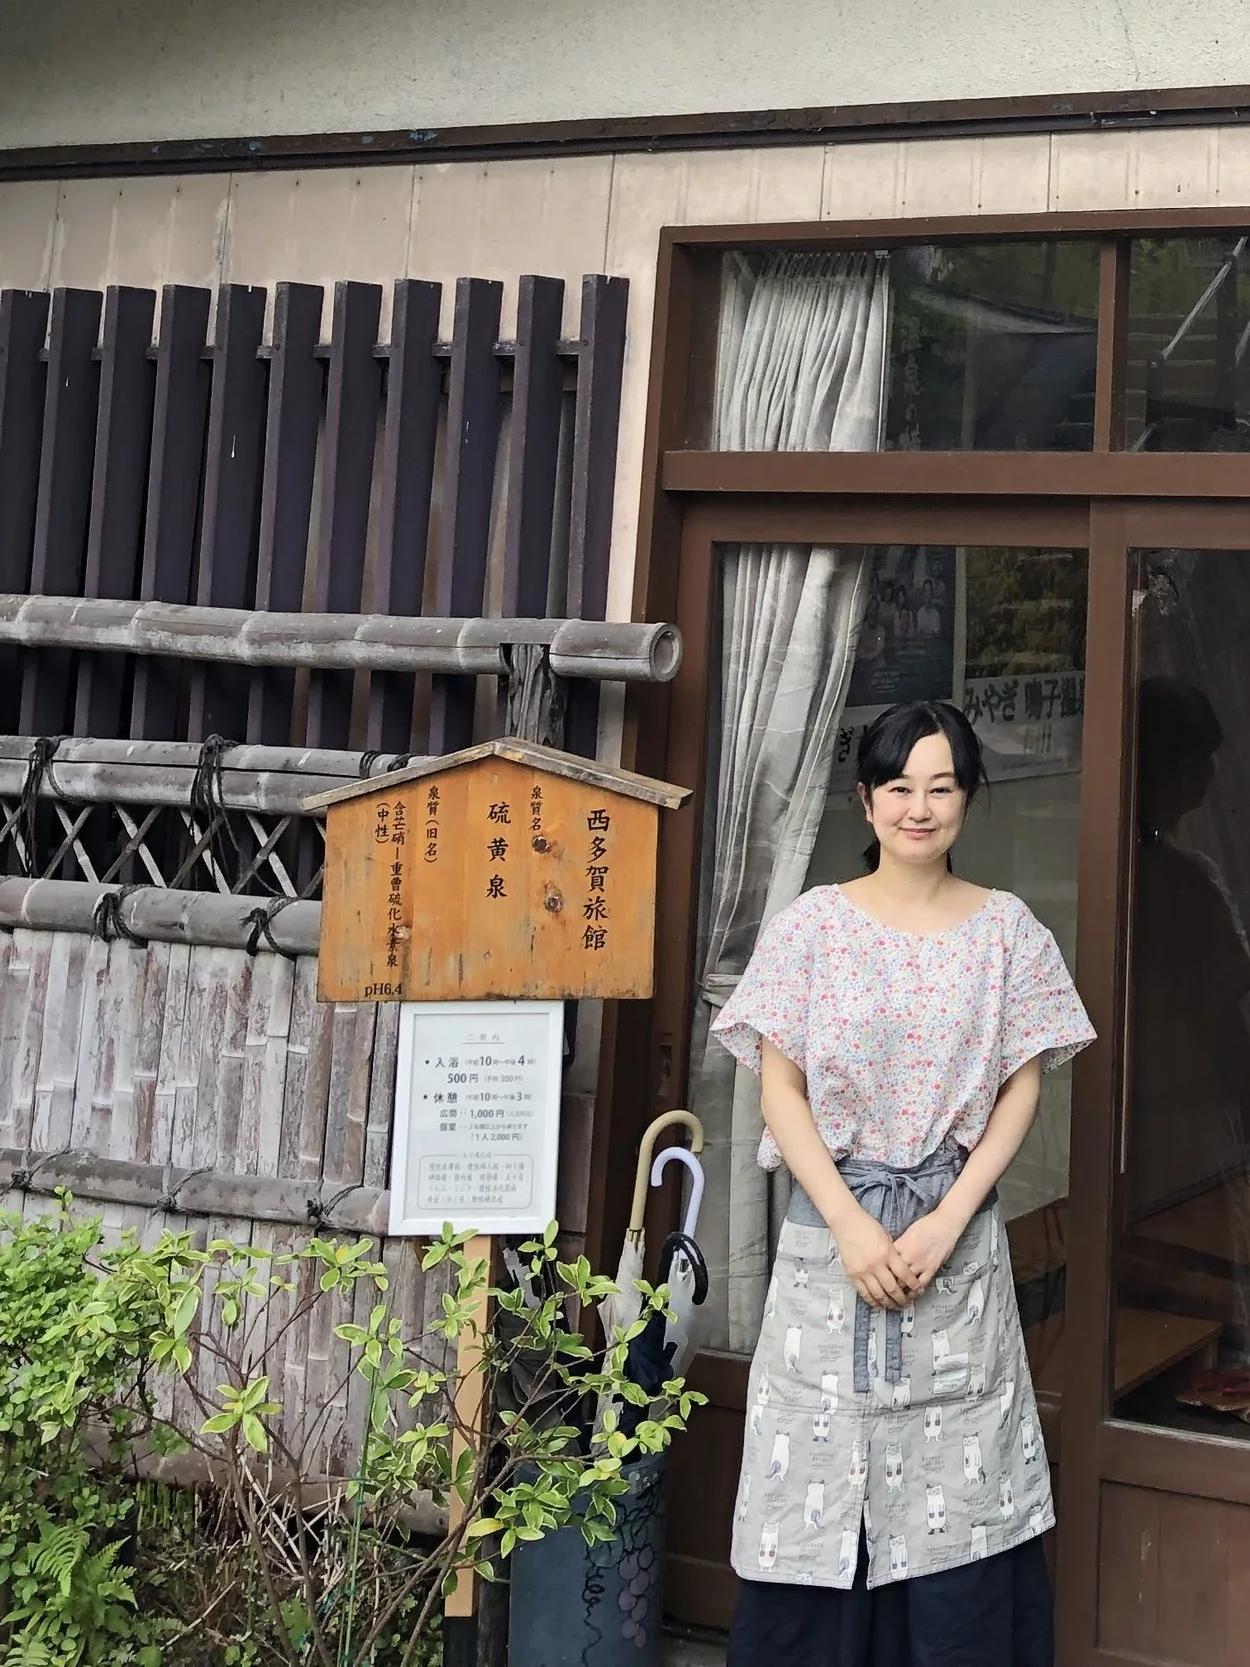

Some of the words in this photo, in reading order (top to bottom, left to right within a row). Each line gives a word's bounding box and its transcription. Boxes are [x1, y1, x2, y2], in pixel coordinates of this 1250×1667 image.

[529, 786, 544, 832] 泉質名
[485, 802, 512, 900] 硫黄泉
[582, 809, 611, 951] 西多賀旅館
[364, 983, 403, 998] pH6.4
[435, 1057, 459, 1068] 入浴
